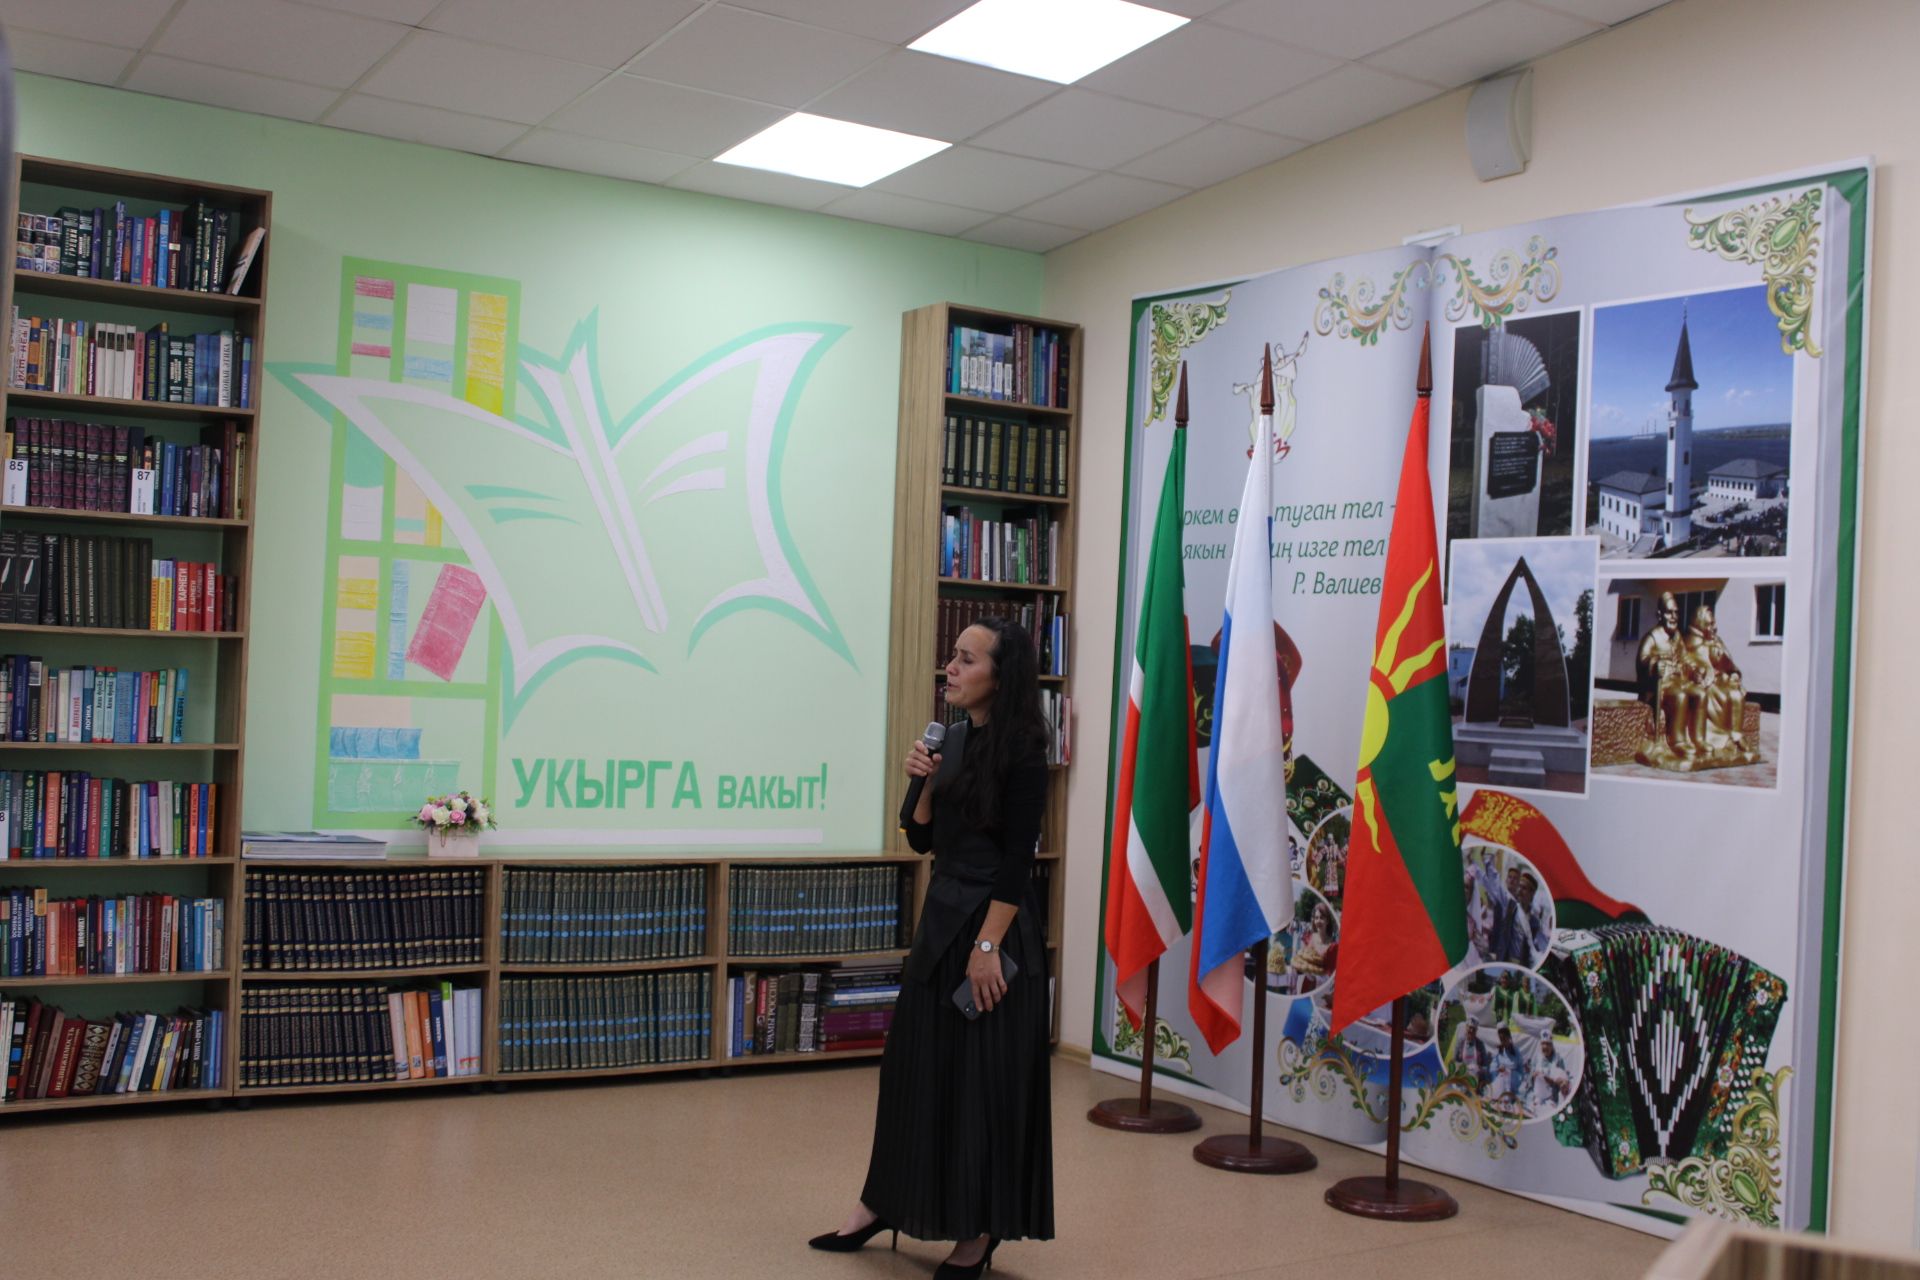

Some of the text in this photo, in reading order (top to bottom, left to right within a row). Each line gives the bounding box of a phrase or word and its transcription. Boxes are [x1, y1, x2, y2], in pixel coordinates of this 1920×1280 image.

[9, 460, 24, 471] 85
[137, 470, 150, 481] 87
[1274, 504, 1336, 528] туган
[1341, 501, 1384, 520] тел
[1298, 541, 1340, 558] изге
[1343, 538, 1386, 557] тел
[177, 567, 188, 602] КАРНЕГИ
[1292, 571, 1305, 595] Р.
[511, 758, 828, 811] УКЫРГА ВАКЫТ!
[766, 977, 777, 1050] ХРАМЫ РОССИИ
